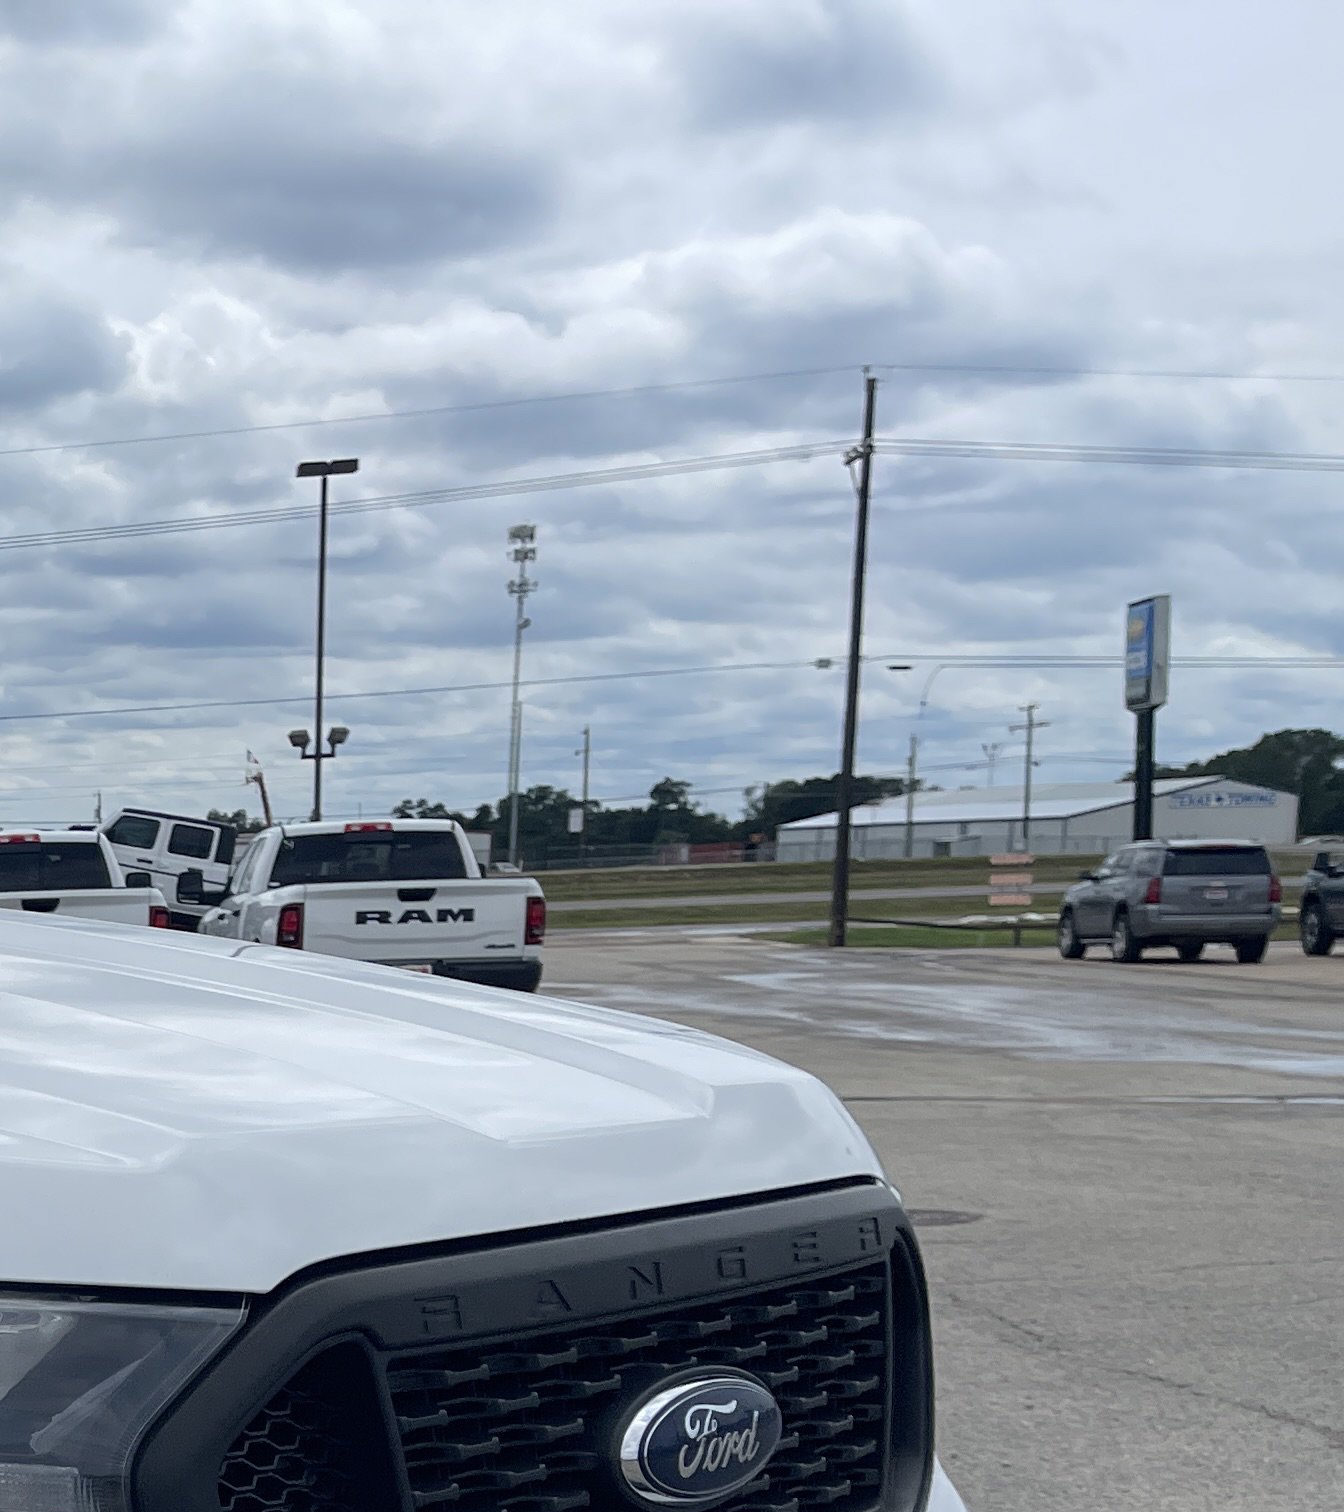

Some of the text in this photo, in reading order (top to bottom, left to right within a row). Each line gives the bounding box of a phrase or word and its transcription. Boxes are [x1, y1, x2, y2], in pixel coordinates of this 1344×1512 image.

[355, 908, 475, 925] RAM
[415, 1216, 882, 1335] RANGER
[678, 1400, 760, 1478] Ford
